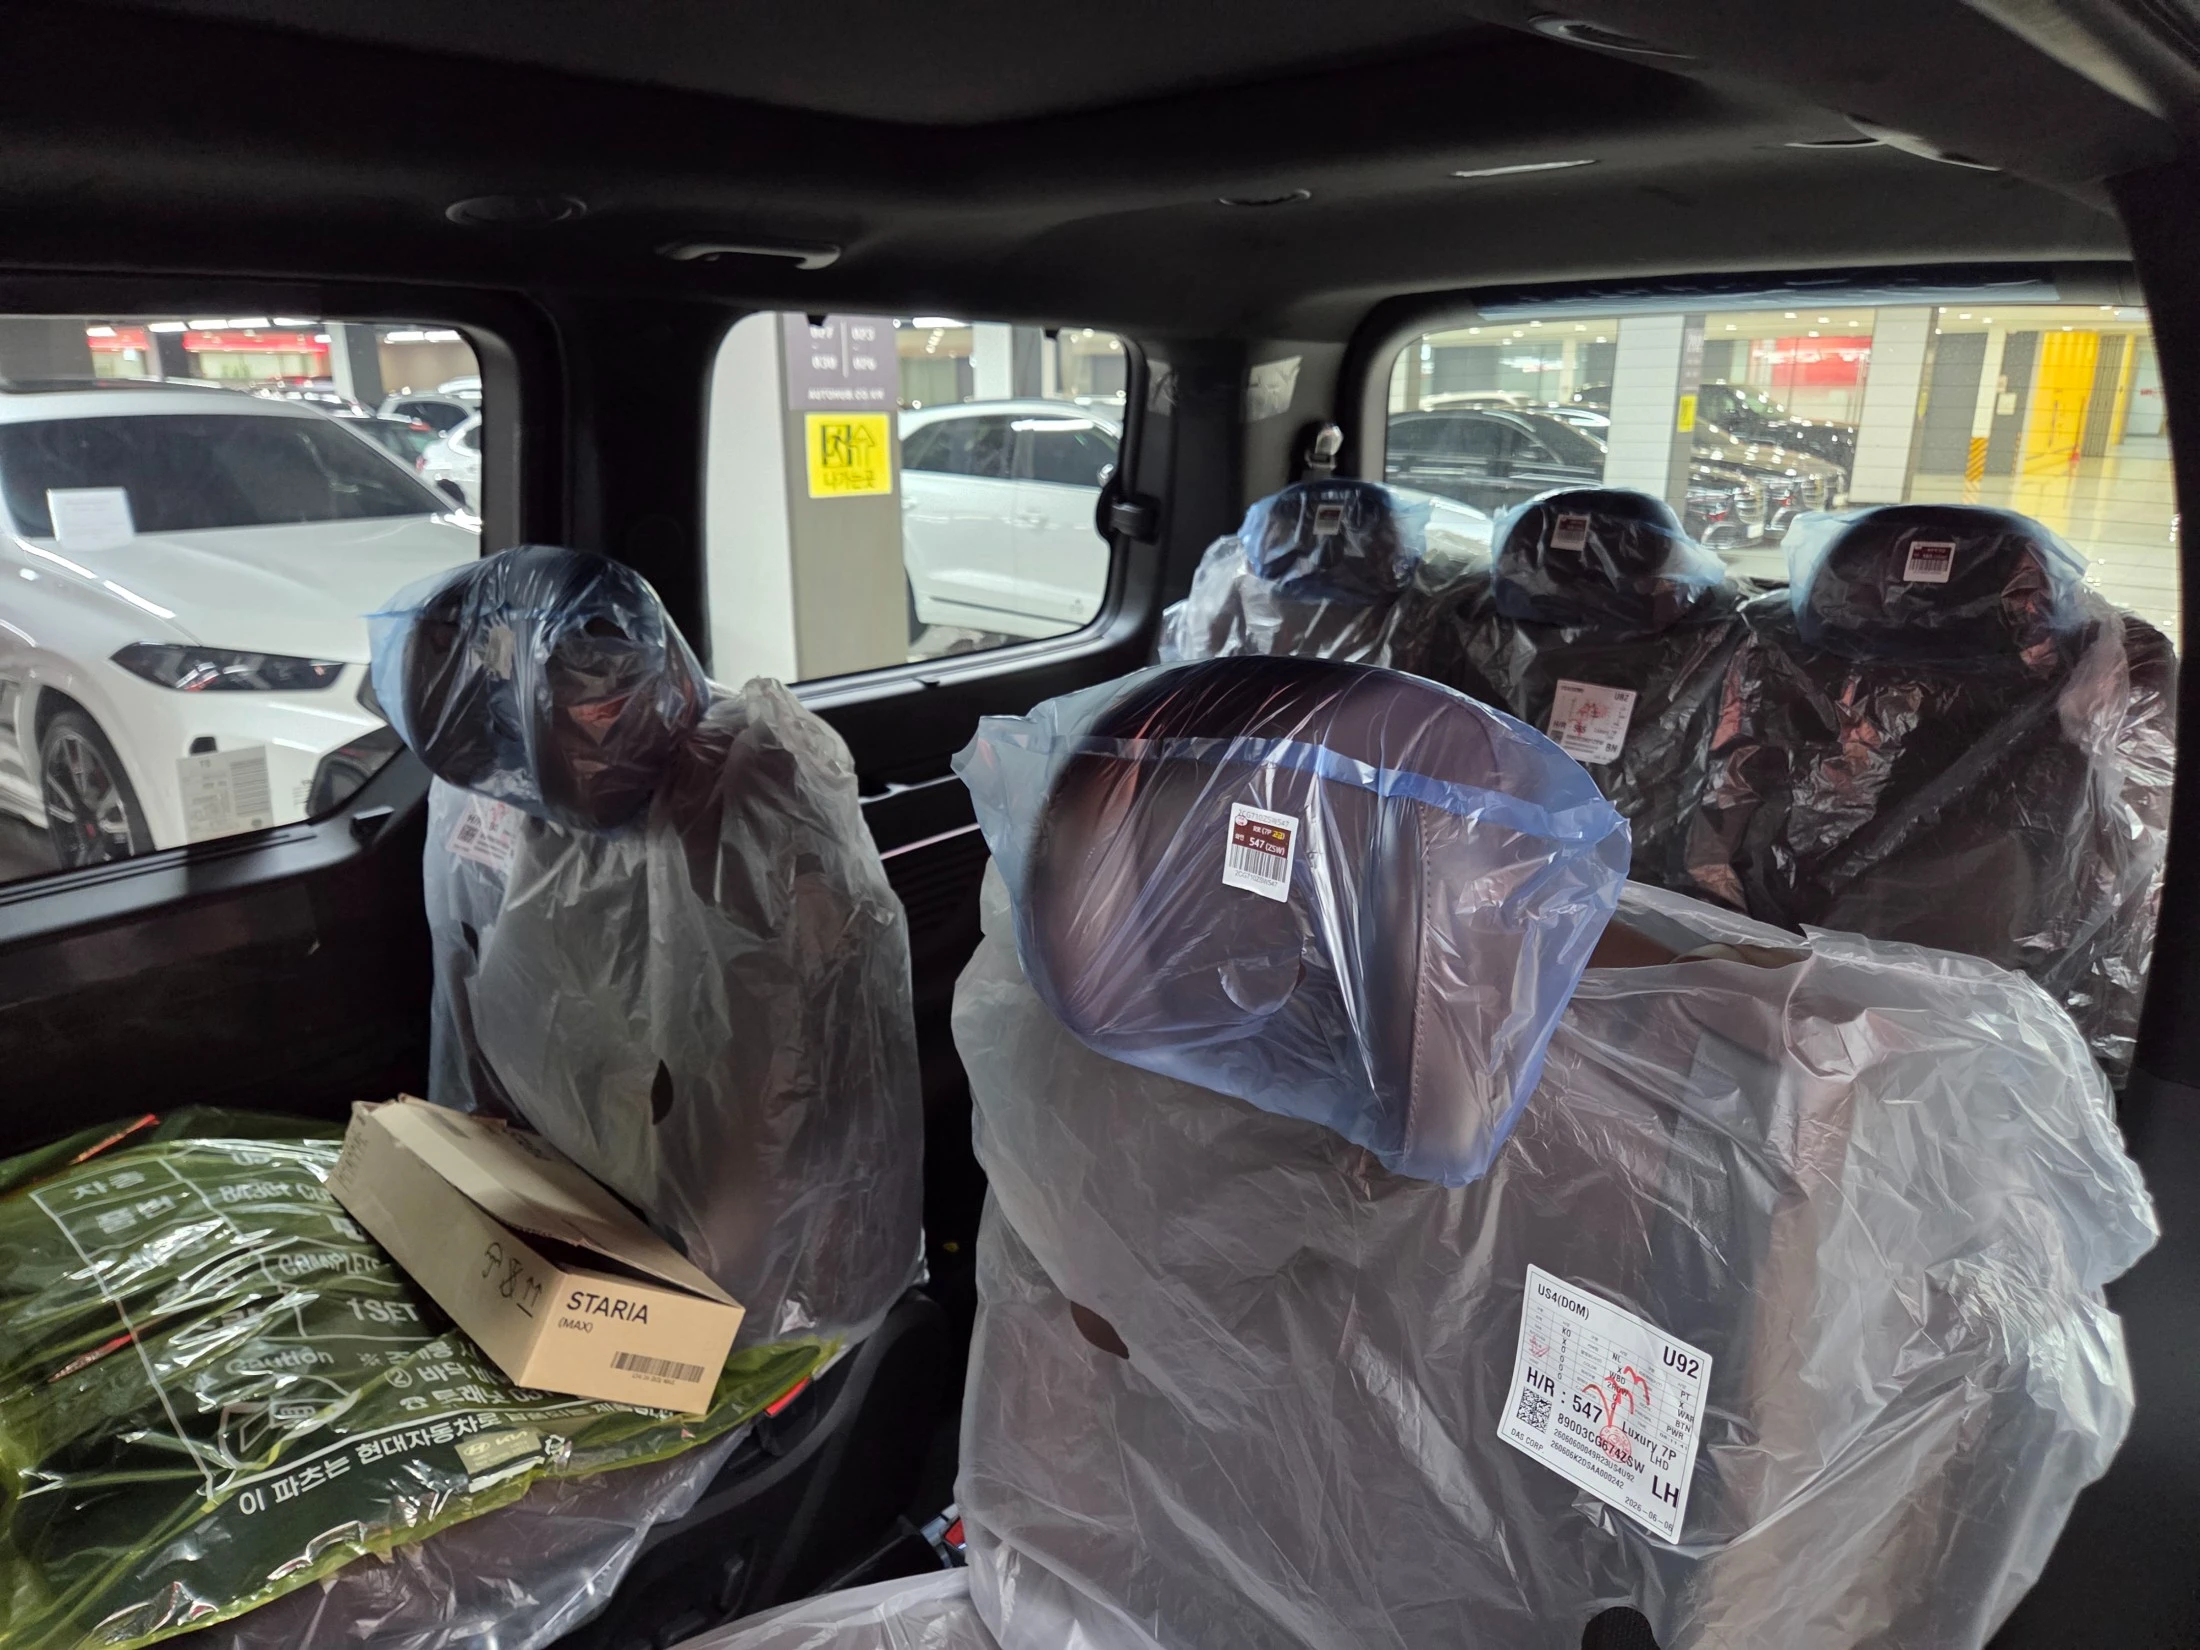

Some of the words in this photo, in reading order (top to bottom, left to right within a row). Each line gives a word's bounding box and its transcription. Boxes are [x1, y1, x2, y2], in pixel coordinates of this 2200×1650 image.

[1248, 836, 1266, 849] 547
[566, 1291, 649, 1325] STARIA
[1537, 1283, 1590, 1321] US4(DOM)
[557, 1316, 594, 1334] (MAX)
[224, 1350, 336, 1374] Caution
[1662, 1345, 1700, 1380] U92
[1526, 1366, 1555, 1397] H/R
[1572, 1394, 1603, 1424] 547
[1680, 1390, 1690, 1401] PT
[1666, 1425, 1684, 1440] PWR
[1675, 1419, 1691, 1433] BTN
[1510, 1427, 1524, 1441] DAS
[1525, 1436, 1545, 1454] CORP.
[1621, 1421, 1659, 1453] Luxury
[1661, 1445, 1677, 1461] 7P
[238, 1487, 266, 1515] 이
[271, 1455, 351, 1504] 파츠는
[355, 1411, 503, 1465] 현대자동차로
[1650, 1450, 1669, 1471] LHD
[1651, 1474, 1680, 1508] LH
